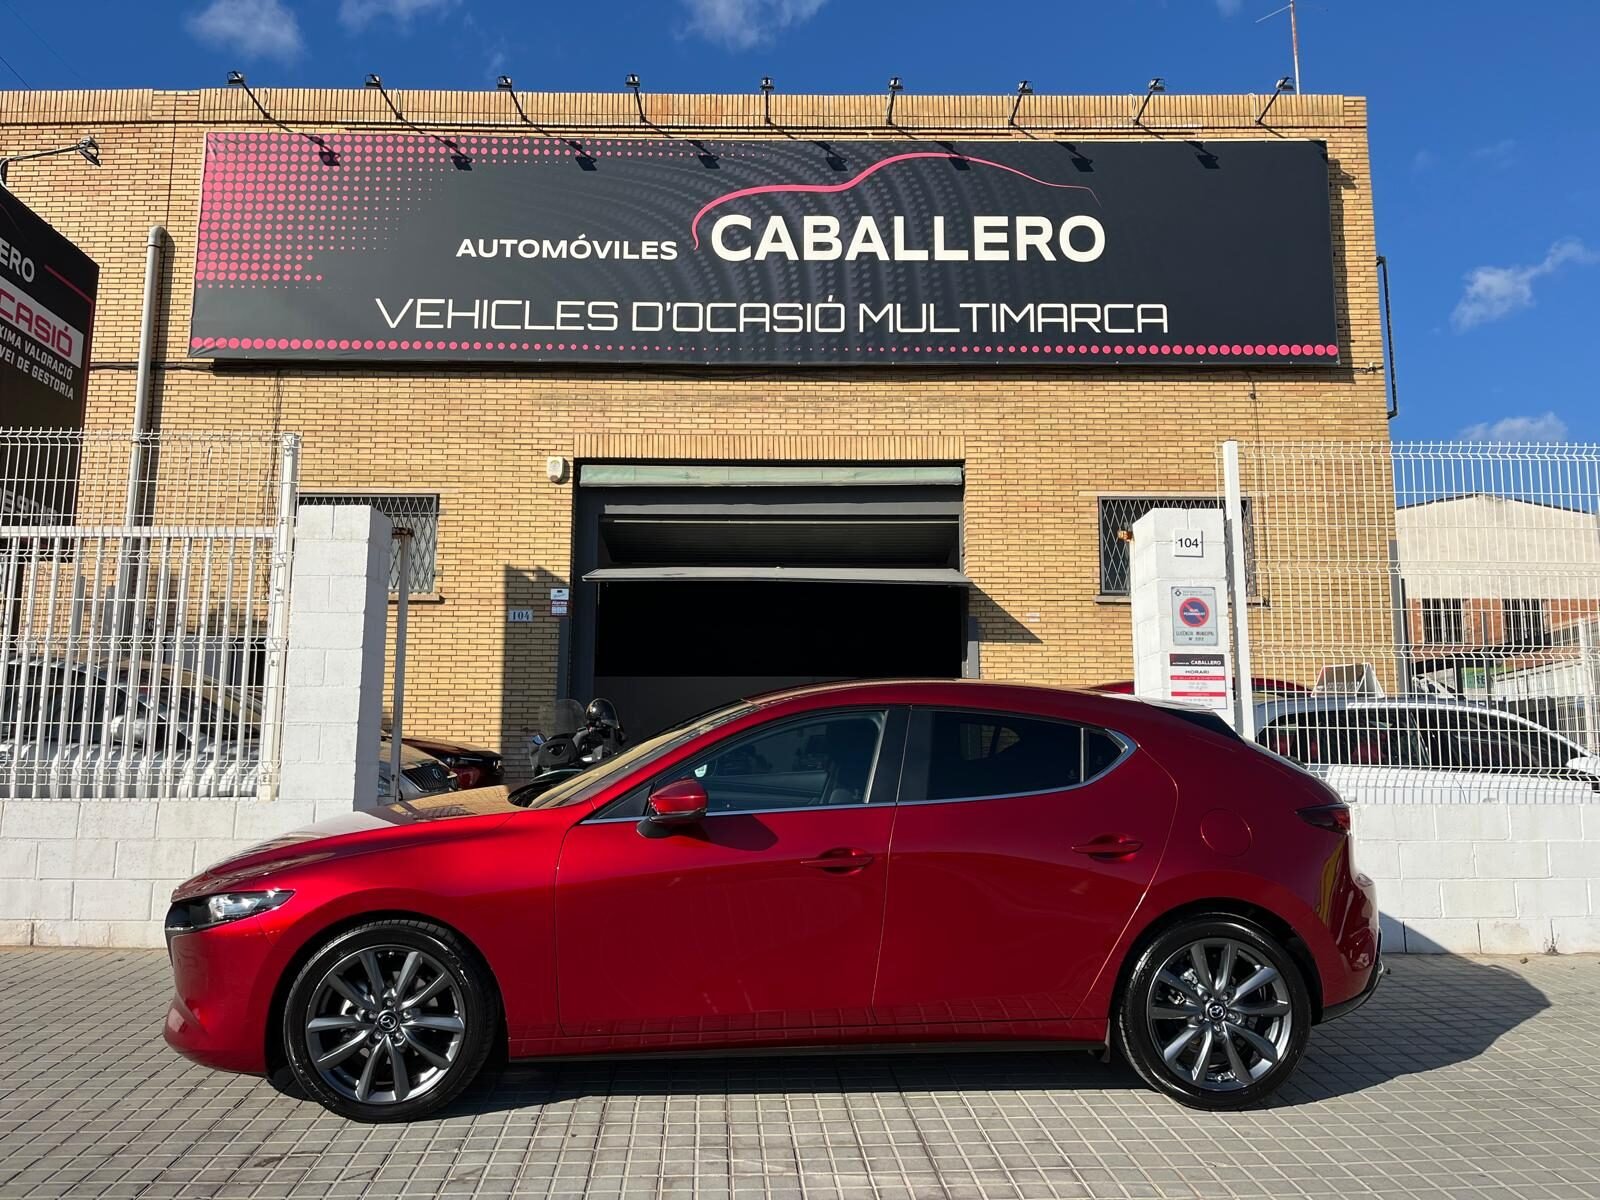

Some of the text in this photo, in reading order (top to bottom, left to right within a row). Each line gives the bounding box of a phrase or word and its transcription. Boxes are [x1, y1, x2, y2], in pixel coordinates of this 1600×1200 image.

[456, 214, 1106, 262] AUTOMÓVILES CABALLERO
[375, 298, 618, 332] VEHICLES
[859, 302, 1169, 334] MULTIMARCA
[16, 355, 31, 374] DE
[32, 365, 74, 400] GESTORIA
[24, 340, 73, 380] VALORACIÓ
[1178, 537, 1199, 548] 104
[513, 611, 530, 620] 104
